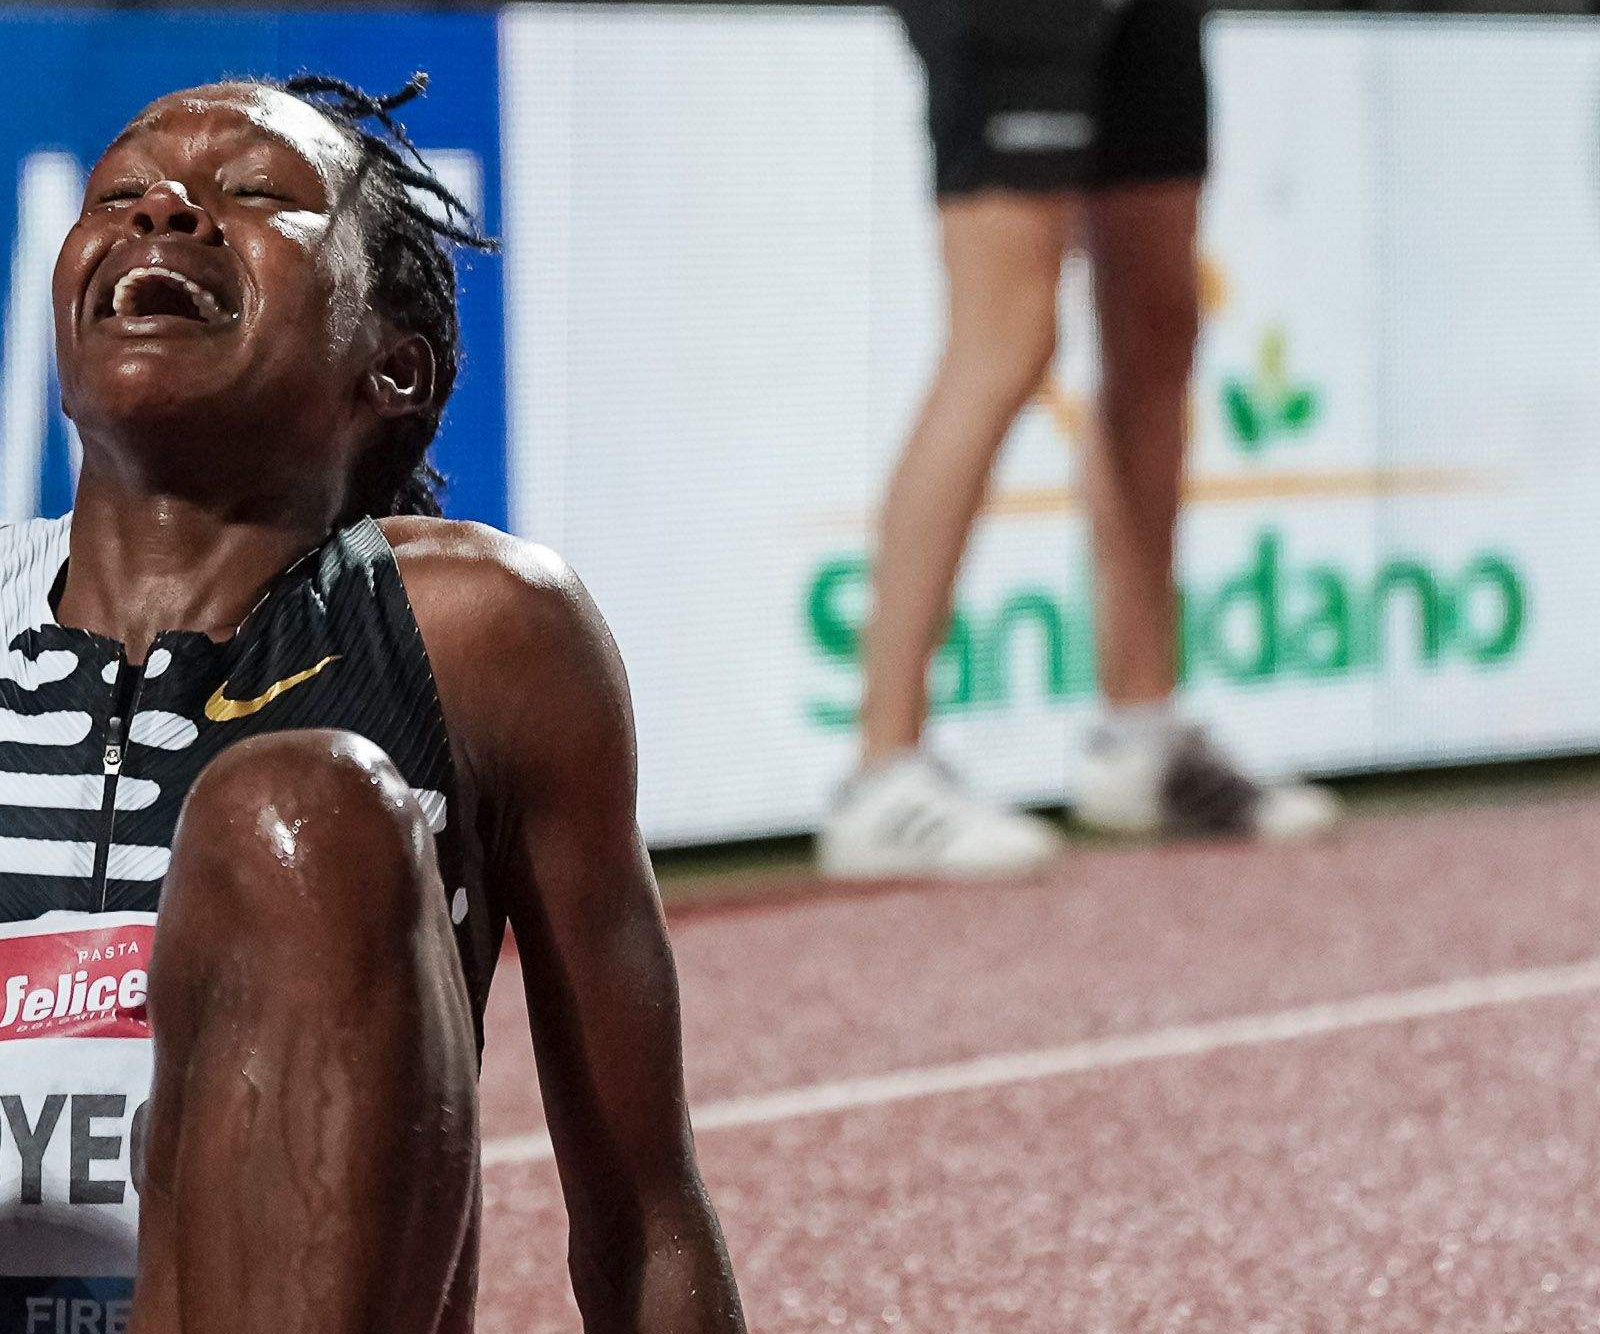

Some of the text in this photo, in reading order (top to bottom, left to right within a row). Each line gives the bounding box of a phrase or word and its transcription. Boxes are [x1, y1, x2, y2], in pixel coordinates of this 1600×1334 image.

[805, 527, 1530, 733] Sandano
[77, 941, 139, 964] PASTA
[0, 969, 149, 1028] felice
